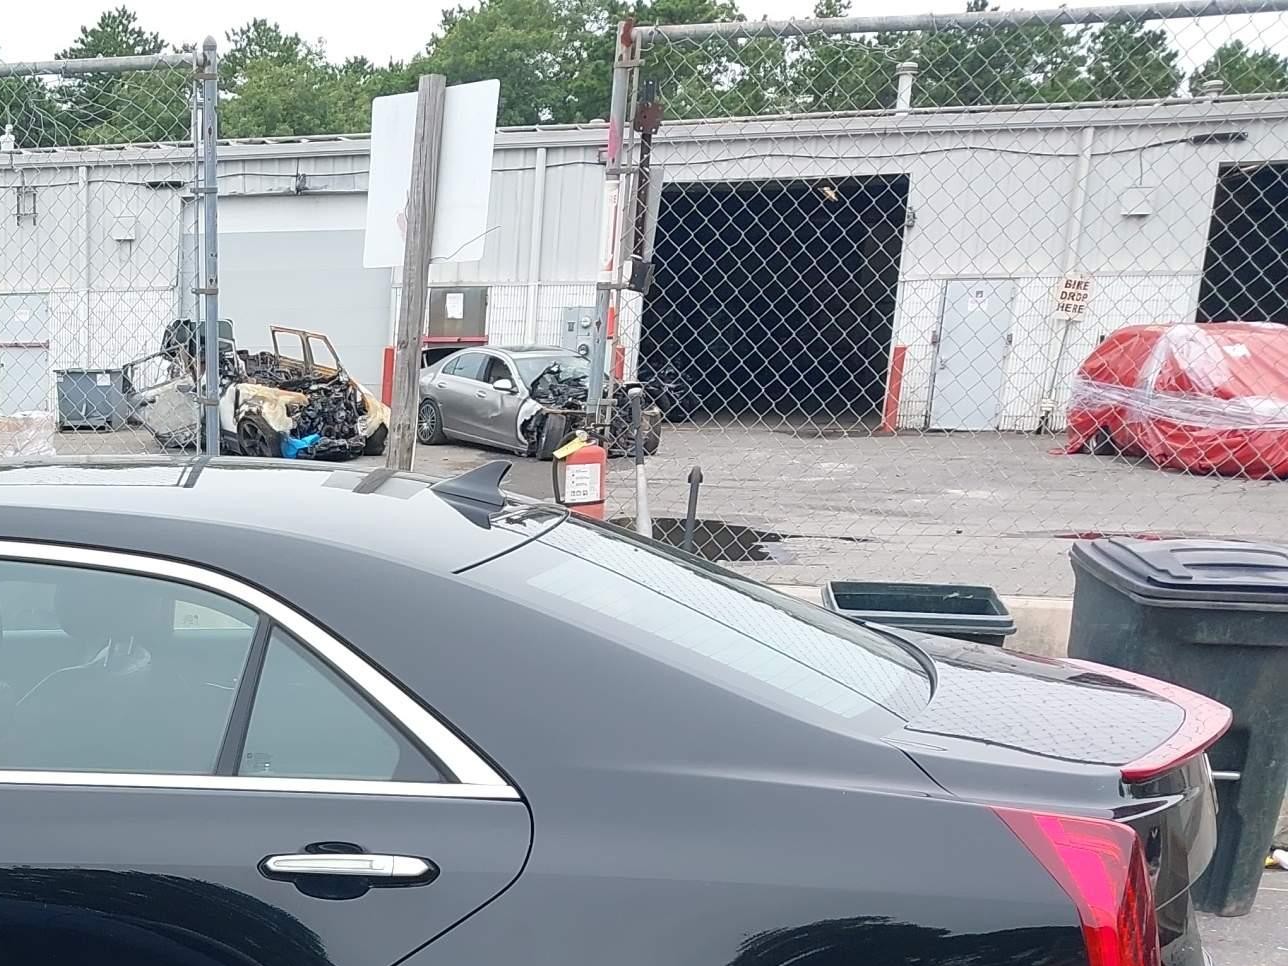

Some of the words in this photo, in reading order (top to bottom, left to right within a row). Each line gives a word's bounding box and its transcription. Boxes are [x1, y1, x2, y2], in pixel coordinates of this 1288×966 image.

[1064, 279, 1090, 291] BIKE
[1060, 291, 1089, 302] DROP
[1056, 302, 1085, 314] HERE
